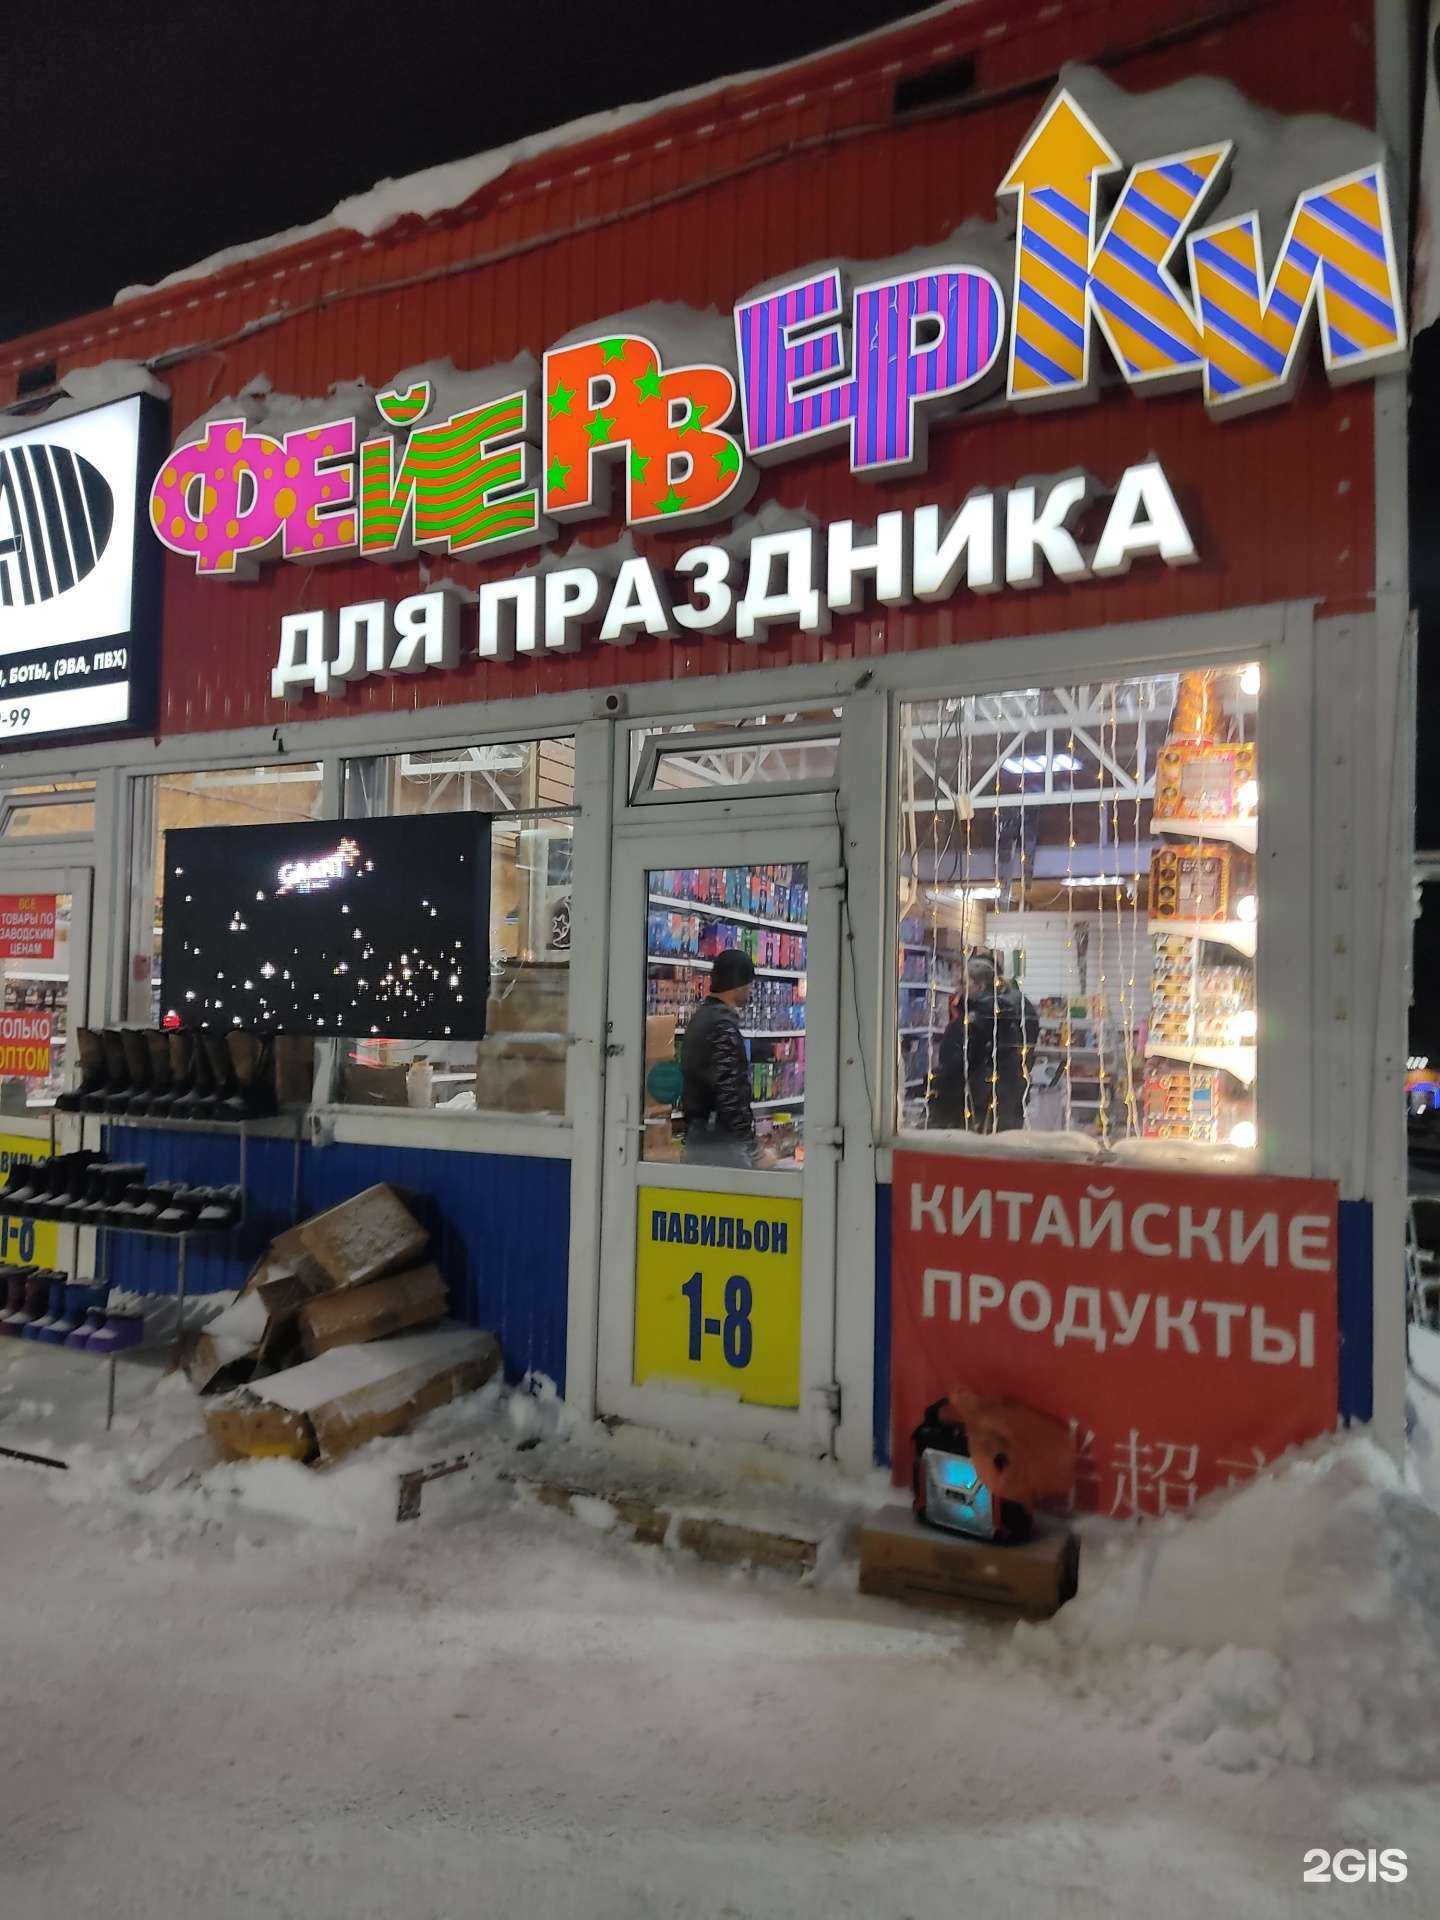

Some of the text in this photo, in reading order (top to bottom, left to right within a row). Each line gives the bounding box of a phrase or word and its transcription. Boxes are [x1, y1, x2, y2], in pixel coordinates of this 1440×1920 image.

[148, 88, 1408, 575] ФЕЙЕРВЕРКИ
[271, 461, 1195, 698] ДЛЯ ПРАЗДНИКА
[9, 662, 51, 684] БОТЫ,
[54, 656, 91, 682] (ЭВА,
[93, 647, 128, 670] ПВХ)
[0, 707, 31, 728] -99
[0, 926, 54, 942] ЗАВОДСКИМ
[1, 912, 54, 925] ТОВАРЫ ПО
[10, 942, 42, 955] ЦЕНАМ
[651, 1209, 788, 1255] ПАВИЛЬОН
[909, 1182, 1332, 1273] КИТАЙСКИЕ
[681, 1271, 753, 1369] 1-8
[921, 1268, 1316, 1368] ПРОДУКТЫ
